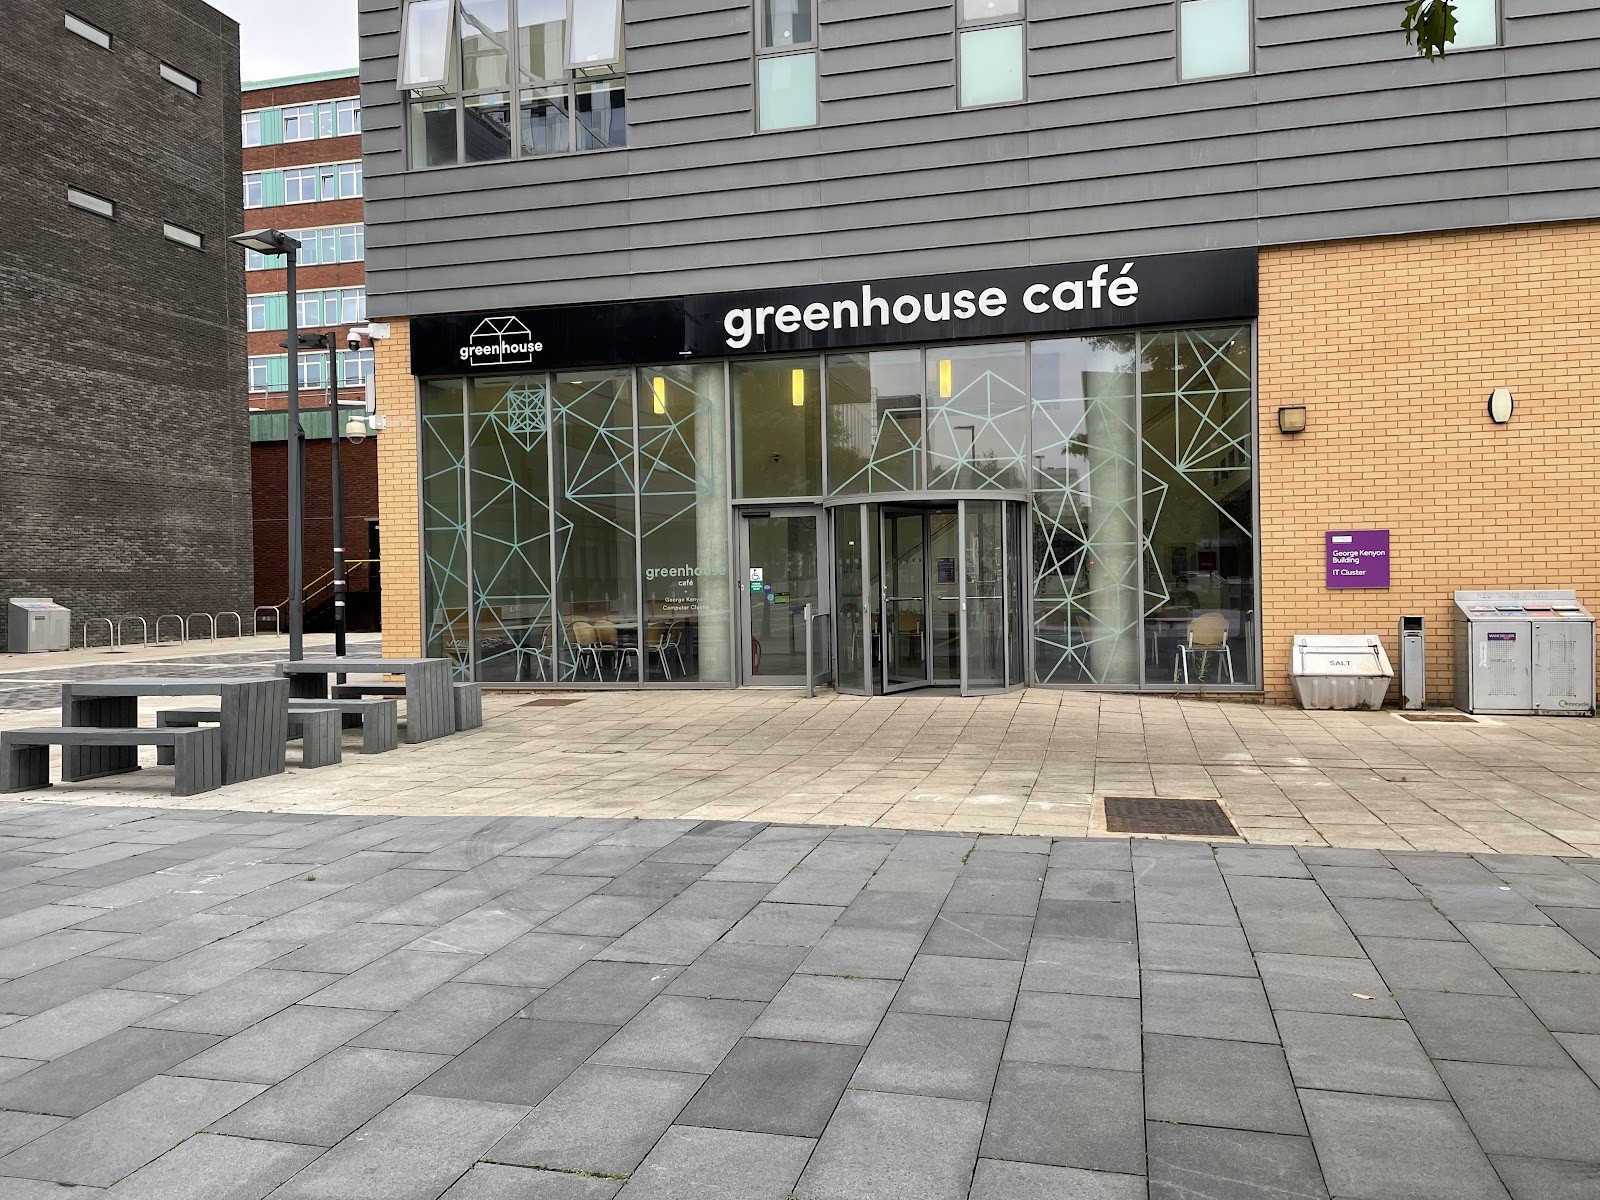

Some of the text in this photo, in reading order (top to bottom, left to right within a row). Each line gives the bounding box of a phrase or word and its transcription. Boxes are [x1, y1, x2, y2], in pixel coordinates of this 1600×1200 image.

[723, 262, 1139, 349] greenhouse café
[459, 340, 543, 360] greenhouse
[1332, 549, 1386, 558] George Kenyon
[1332, 557, 1360, 565] Building
[646, 564, 726, 580] greenhouse
[678, 578, 694, 587] café
